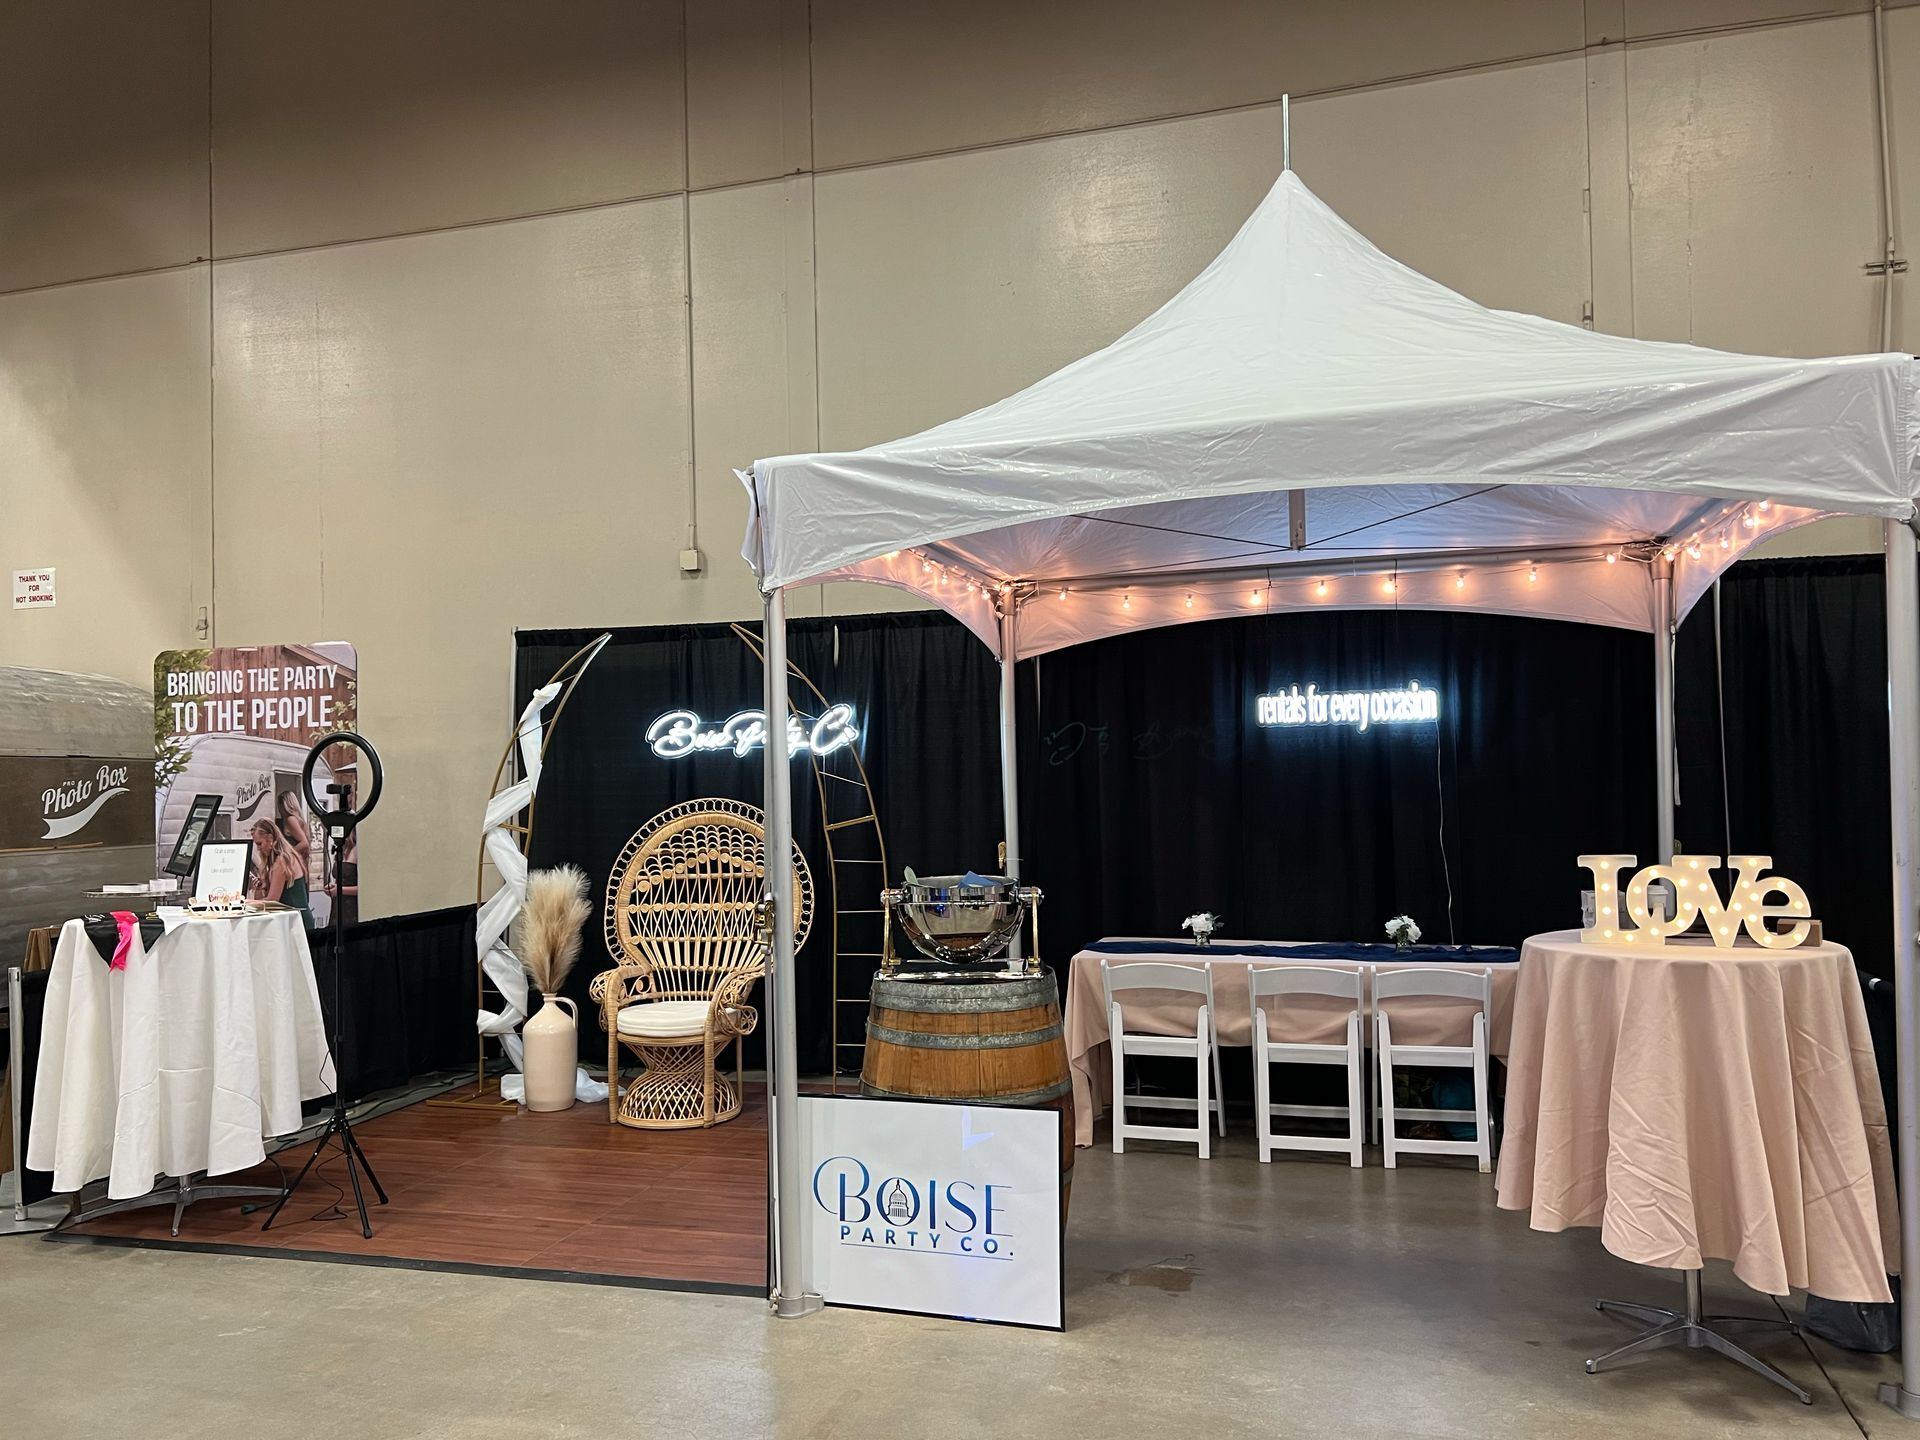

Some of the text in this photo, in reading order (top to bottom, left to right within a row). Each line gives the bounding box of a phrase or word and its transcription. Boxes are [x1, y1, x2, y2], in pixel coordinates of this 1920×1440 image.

[28, 594, 53, 602] SMOKING
[167, 664, 338, 697] BRINGING THE PARTY
[171, 695, 333, 733] TO THE PEOPLE
[1258, 682, 1438, 731] rentals for every occasion
[41, 764, 129, 815] Photo Box
[236, 783, 257, 805] Photo
[813, 1156, 1014, 1237] BOISE
[840, 1225, 1014, 1257] PARTY CO.
